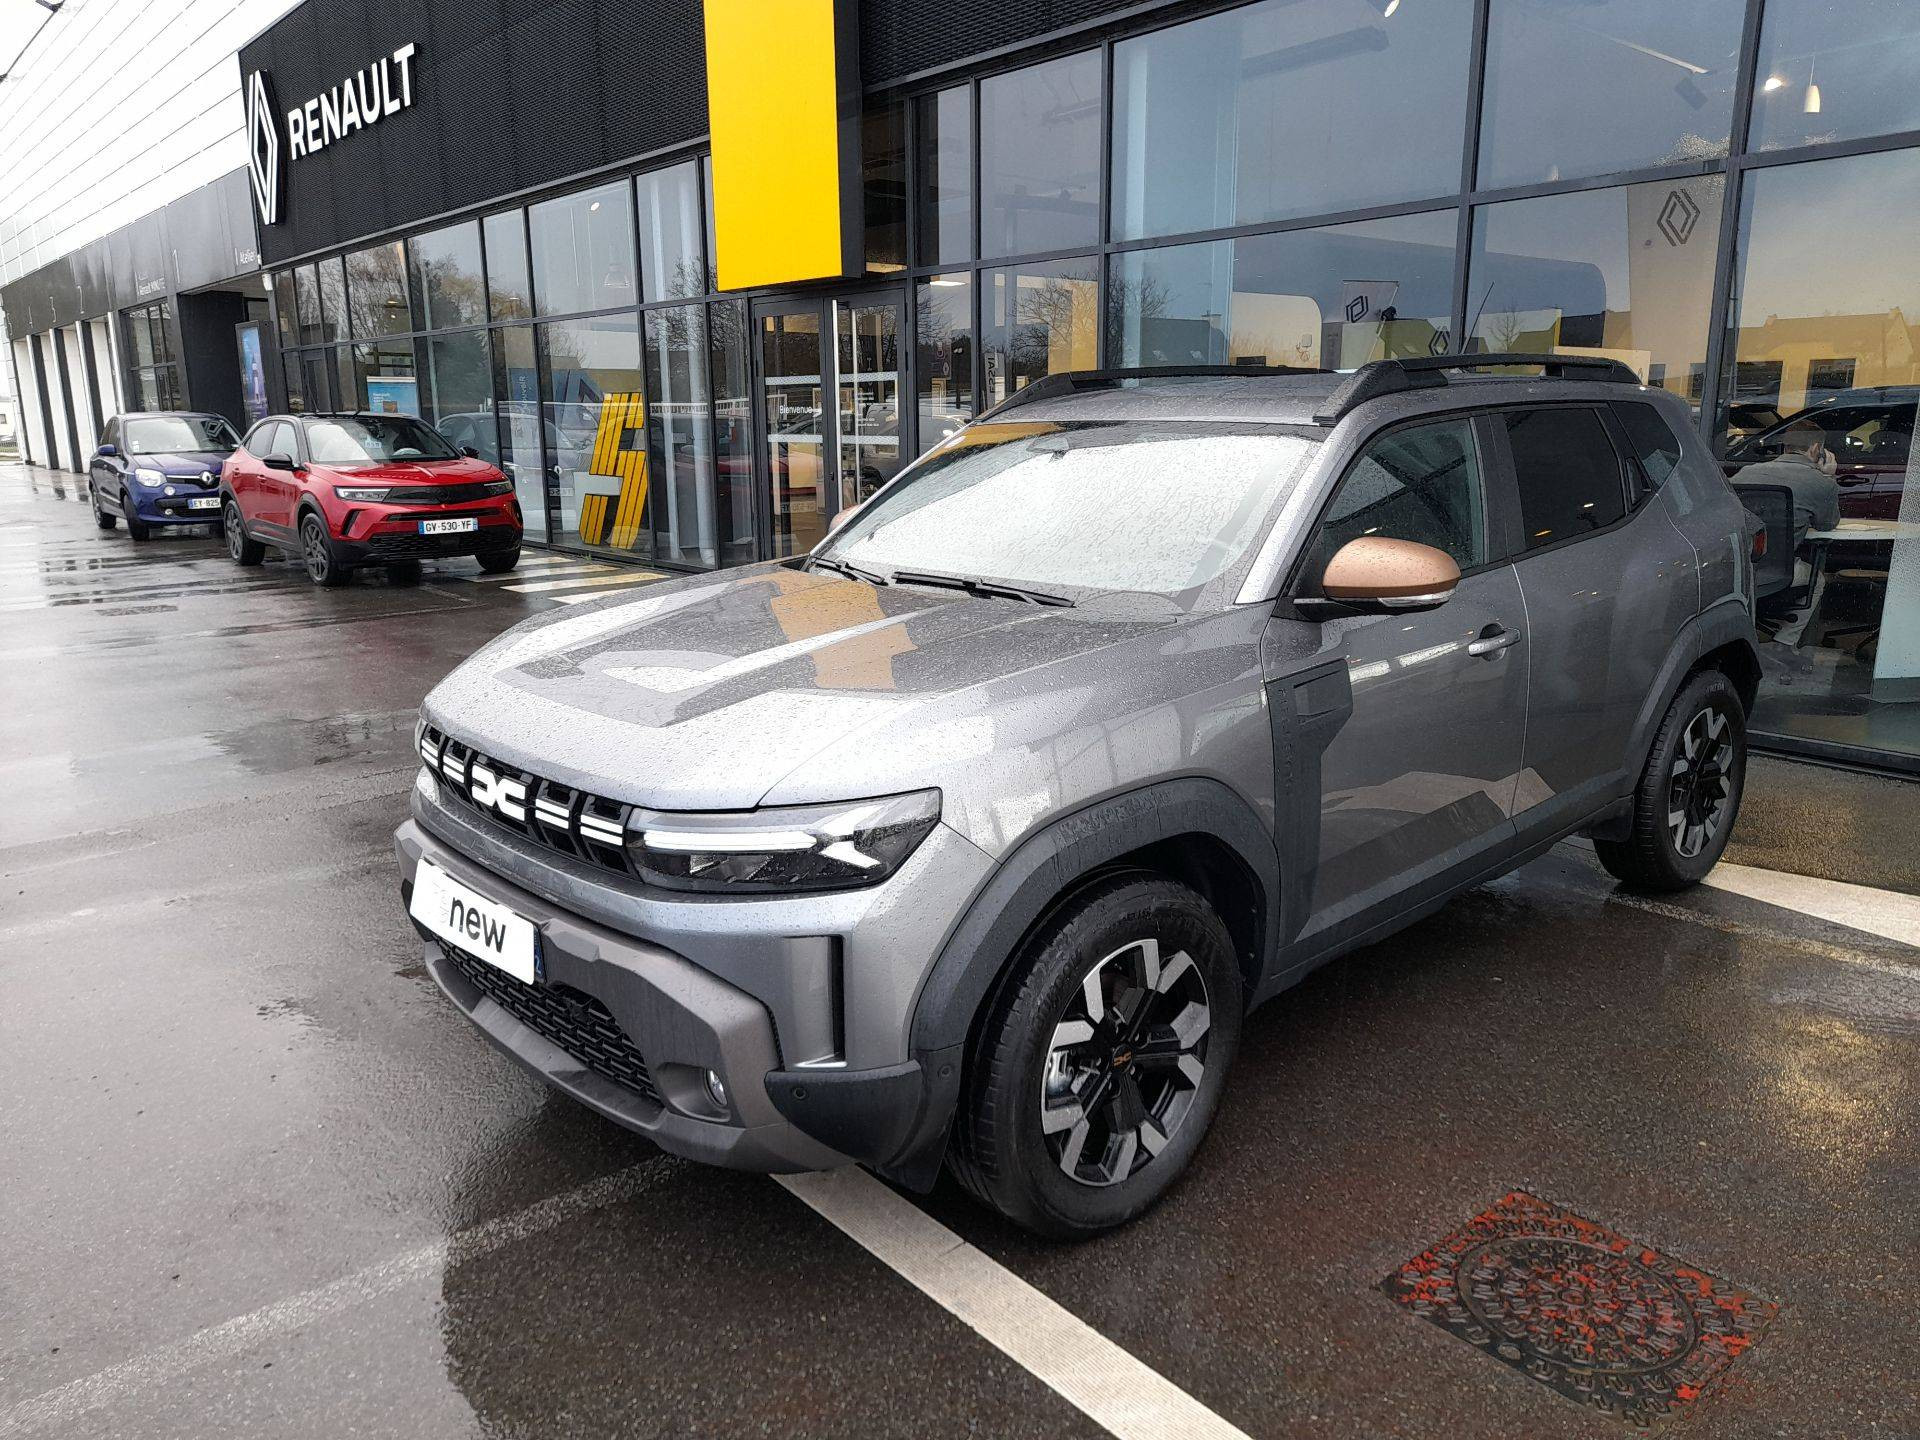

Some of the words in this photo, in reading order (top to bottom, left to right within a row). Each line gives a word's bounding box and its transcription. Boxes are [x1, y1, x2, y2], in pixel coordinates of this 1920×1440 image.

[288, 42, 415, 161] RENAULT
[779, 404, 813, 415] Bienvenue
[425, 520, 472, 532] GV-530-YF
[449, 896, 506, 953] new
